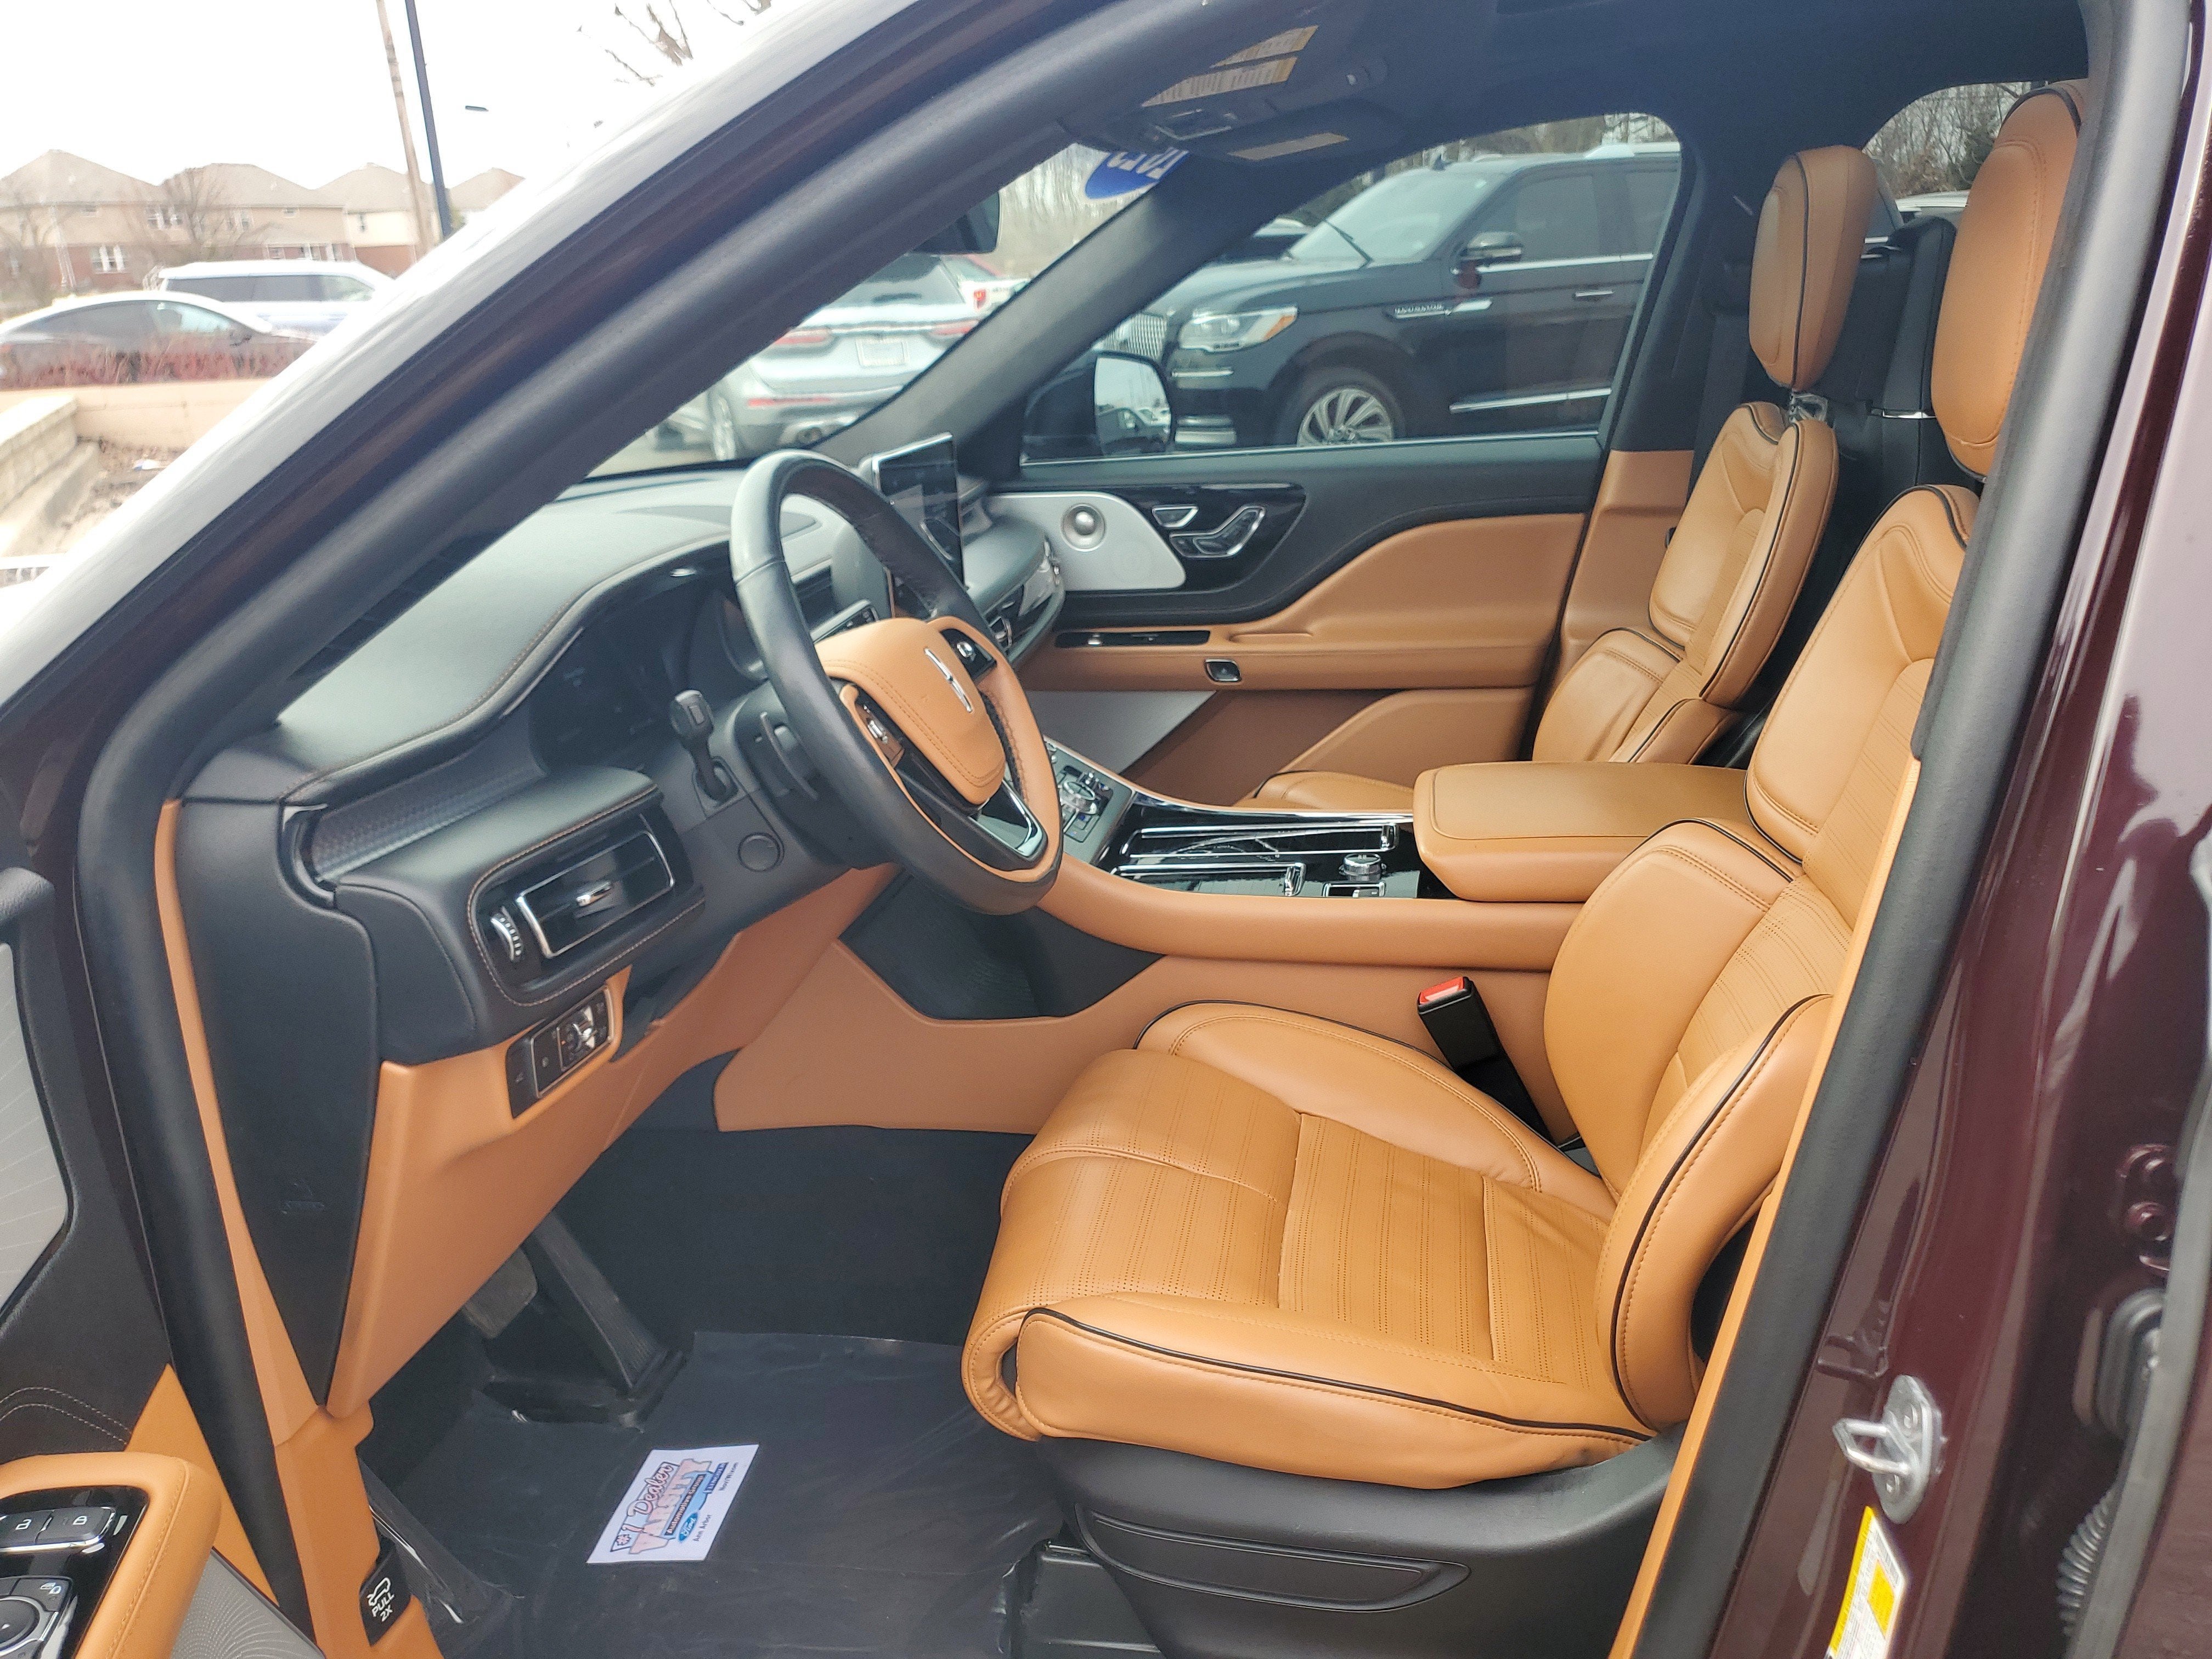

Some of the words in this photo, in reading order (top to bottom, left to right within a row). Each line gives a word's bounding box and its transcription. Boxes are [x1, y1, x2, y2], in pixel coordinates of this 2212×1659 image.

[627, 1464, 675, 1517] Dealer
[628, 1458, 713, 1554] VARSITY
[372, 1592, 394, 1617] PULL
[380, 1604, 393, 1622] 2X
